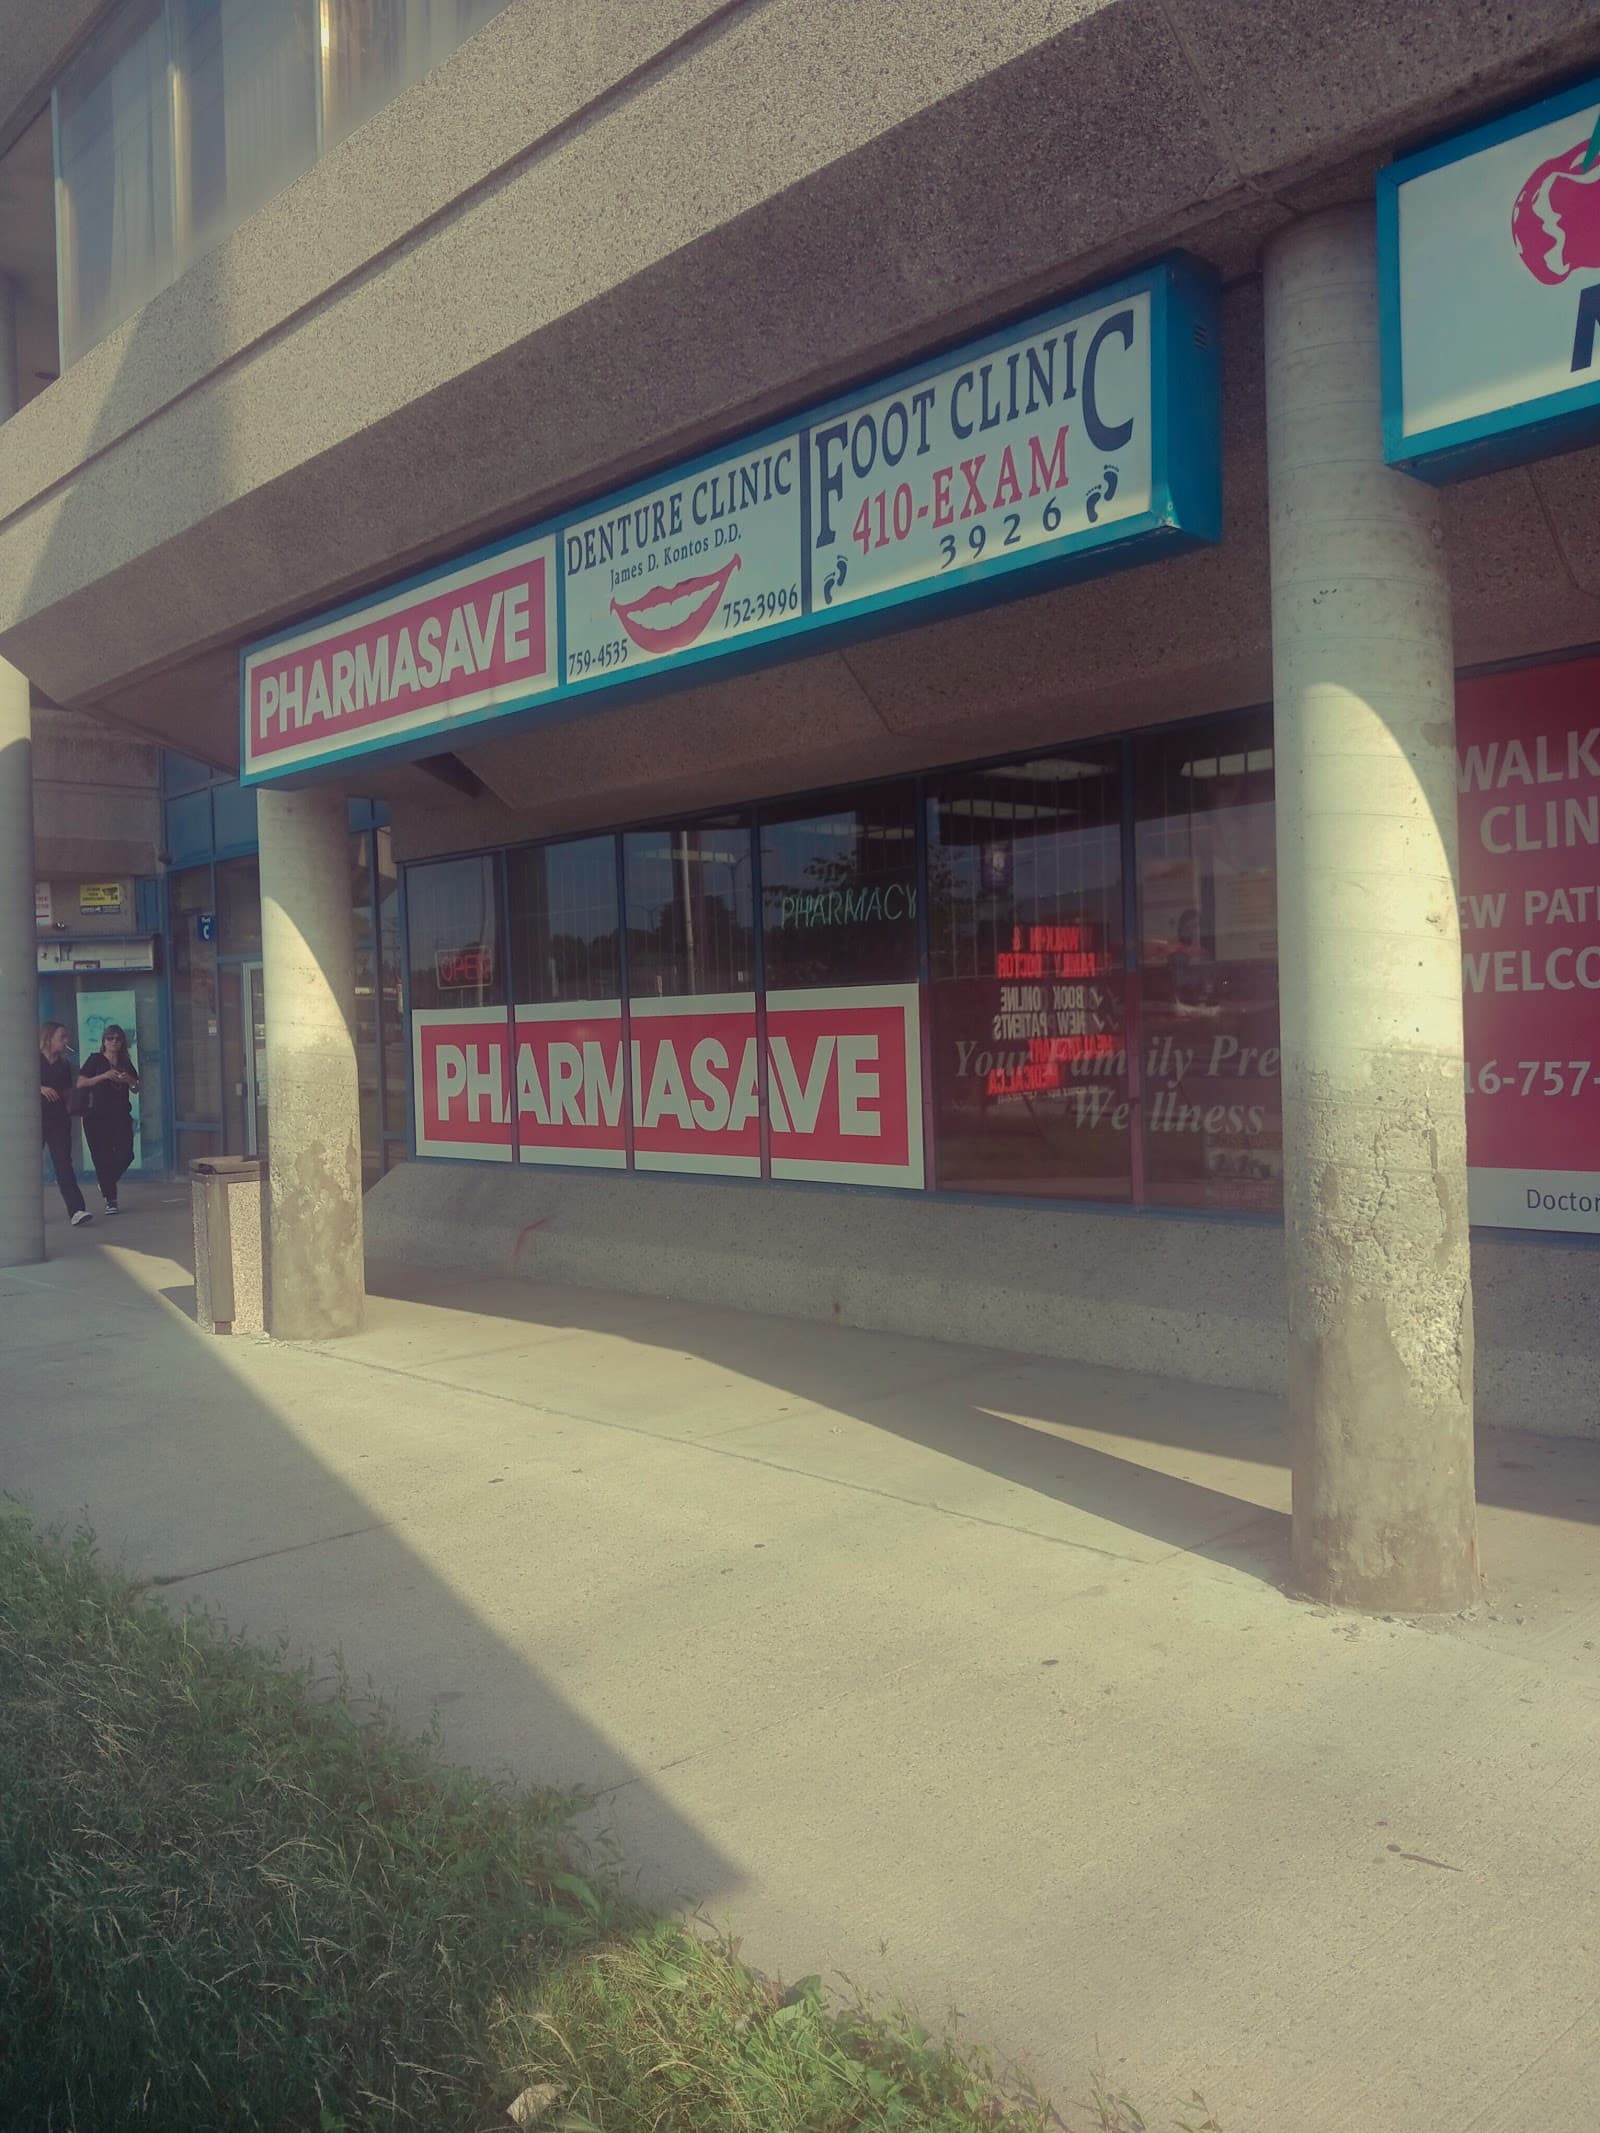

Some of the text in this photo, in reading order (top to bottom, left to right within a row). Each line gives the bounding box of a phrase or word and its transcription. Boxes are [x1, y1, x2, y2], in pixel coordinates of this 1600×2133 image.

[816, 309, 1134, 549] FOOT CLINIC
[567, 449, 792, 576] DENTURE CLINIC
[852, 425, 1070, 555] 410-EXAM
[610, 522, 742, 592] James D. Kontos D.D.
[723, 583, 799, 629] 752-3996
[259, 582, 530, 739] PHARMASAVE
[568, 639, 629, 676] 759-4535
[1480, 796, 1599, 854] CLIN
[781, 884, 917, 929] PHARMACY
[435, 1034, 881, 1137] PHARMASAVE
[954, 1040, 1032, 1078] Your
[1073, 1091, 1265, 1137] Wellness
